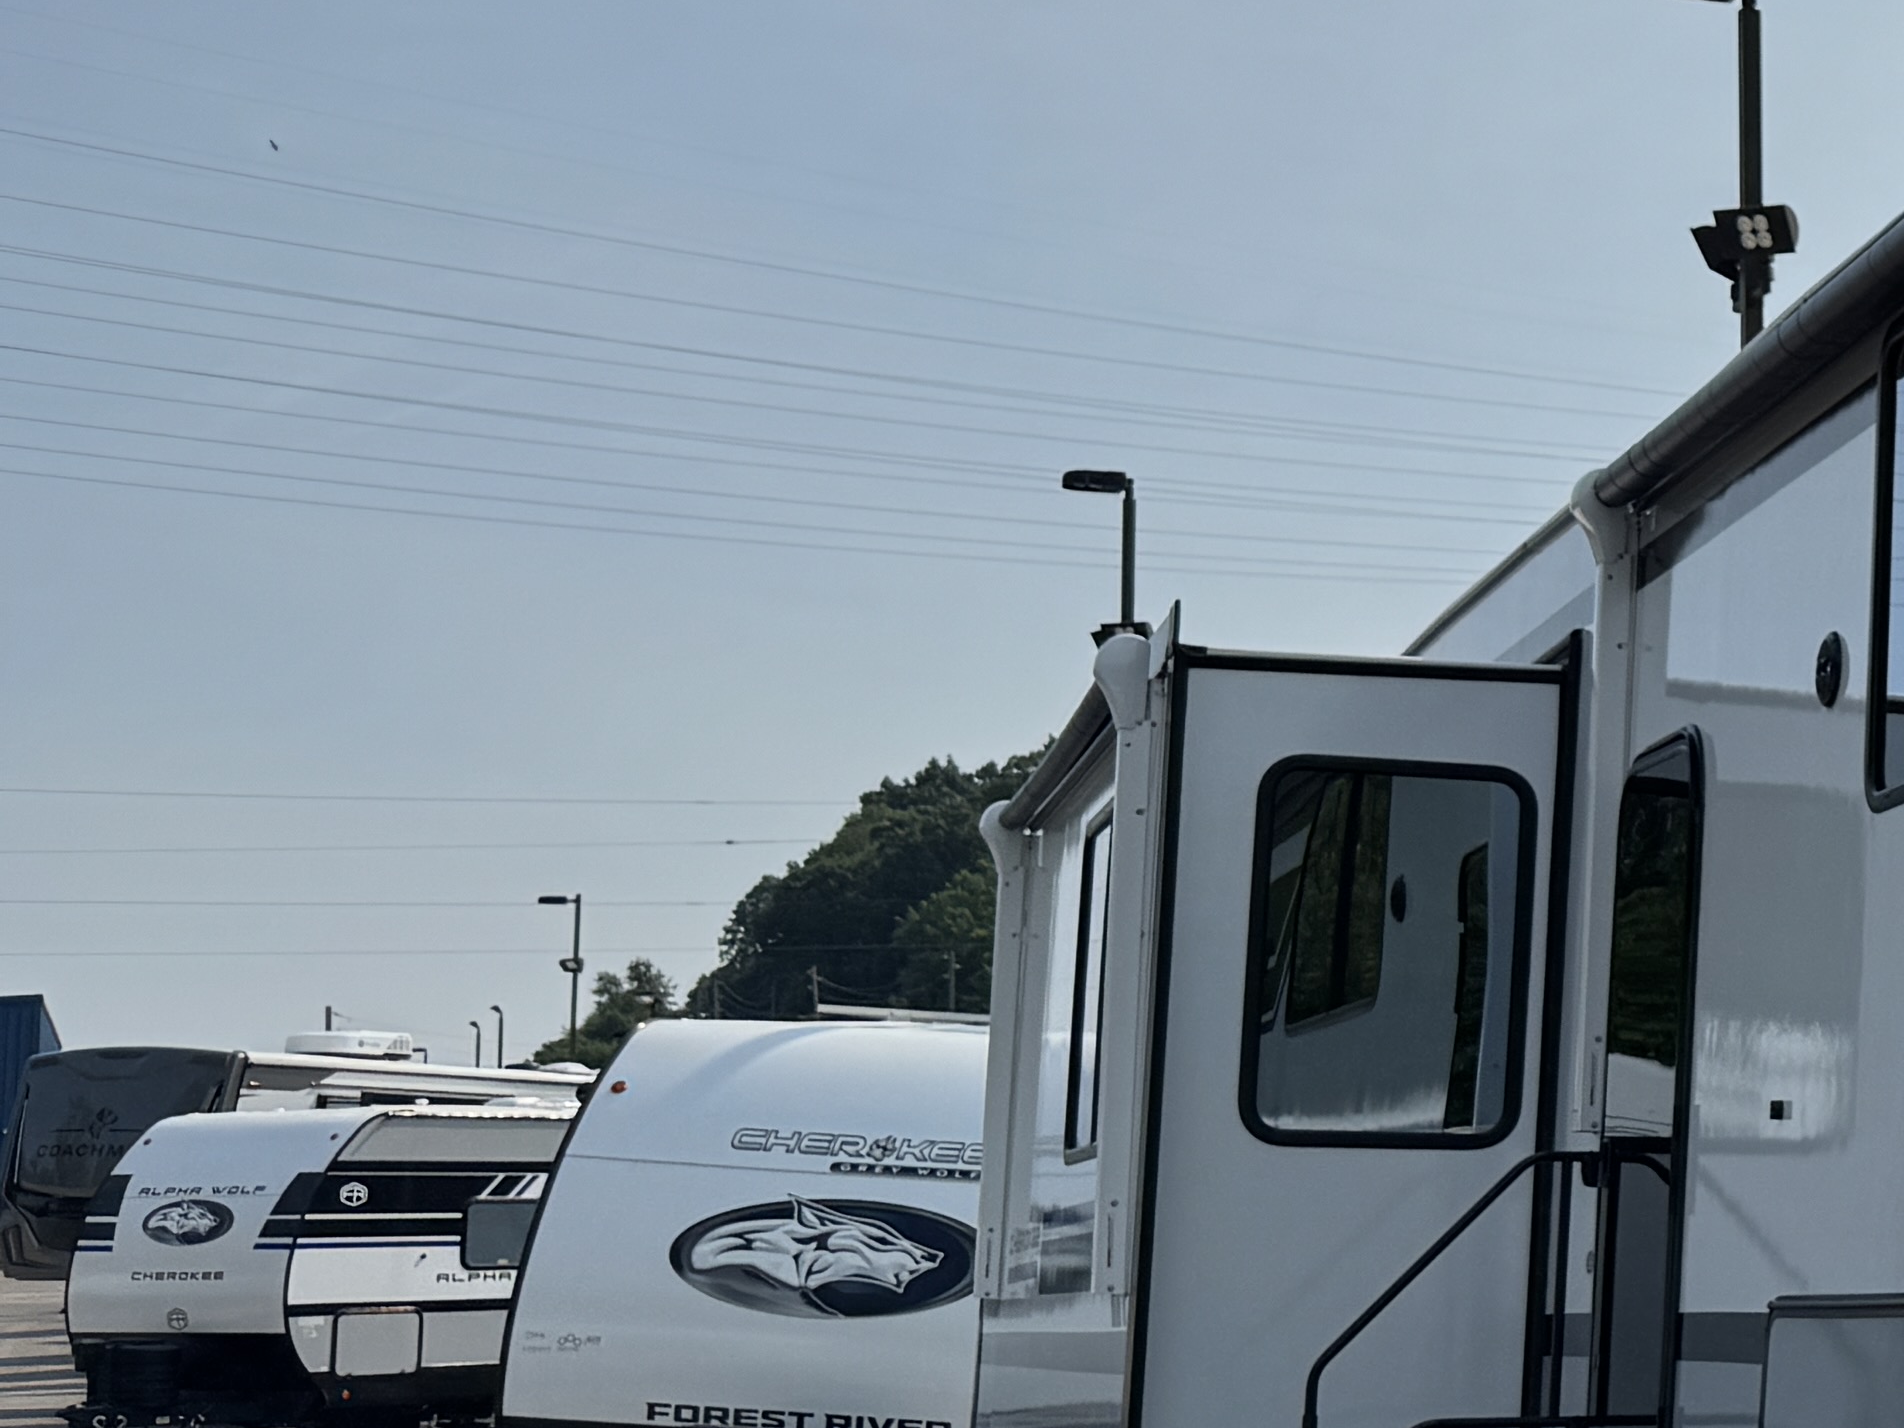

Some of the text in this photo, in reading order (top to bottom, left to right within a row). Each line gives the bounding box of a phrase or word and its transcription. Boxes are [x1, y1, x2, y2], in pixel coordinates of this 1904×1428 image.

[839, 1163, 900, 1174] GREY
[138, 1185, 267, 1196] ALPHA WOLF
[131, 1271, 224, 1281] CHEROKEE
[436, 1272, 511, 1283] ALPHA
